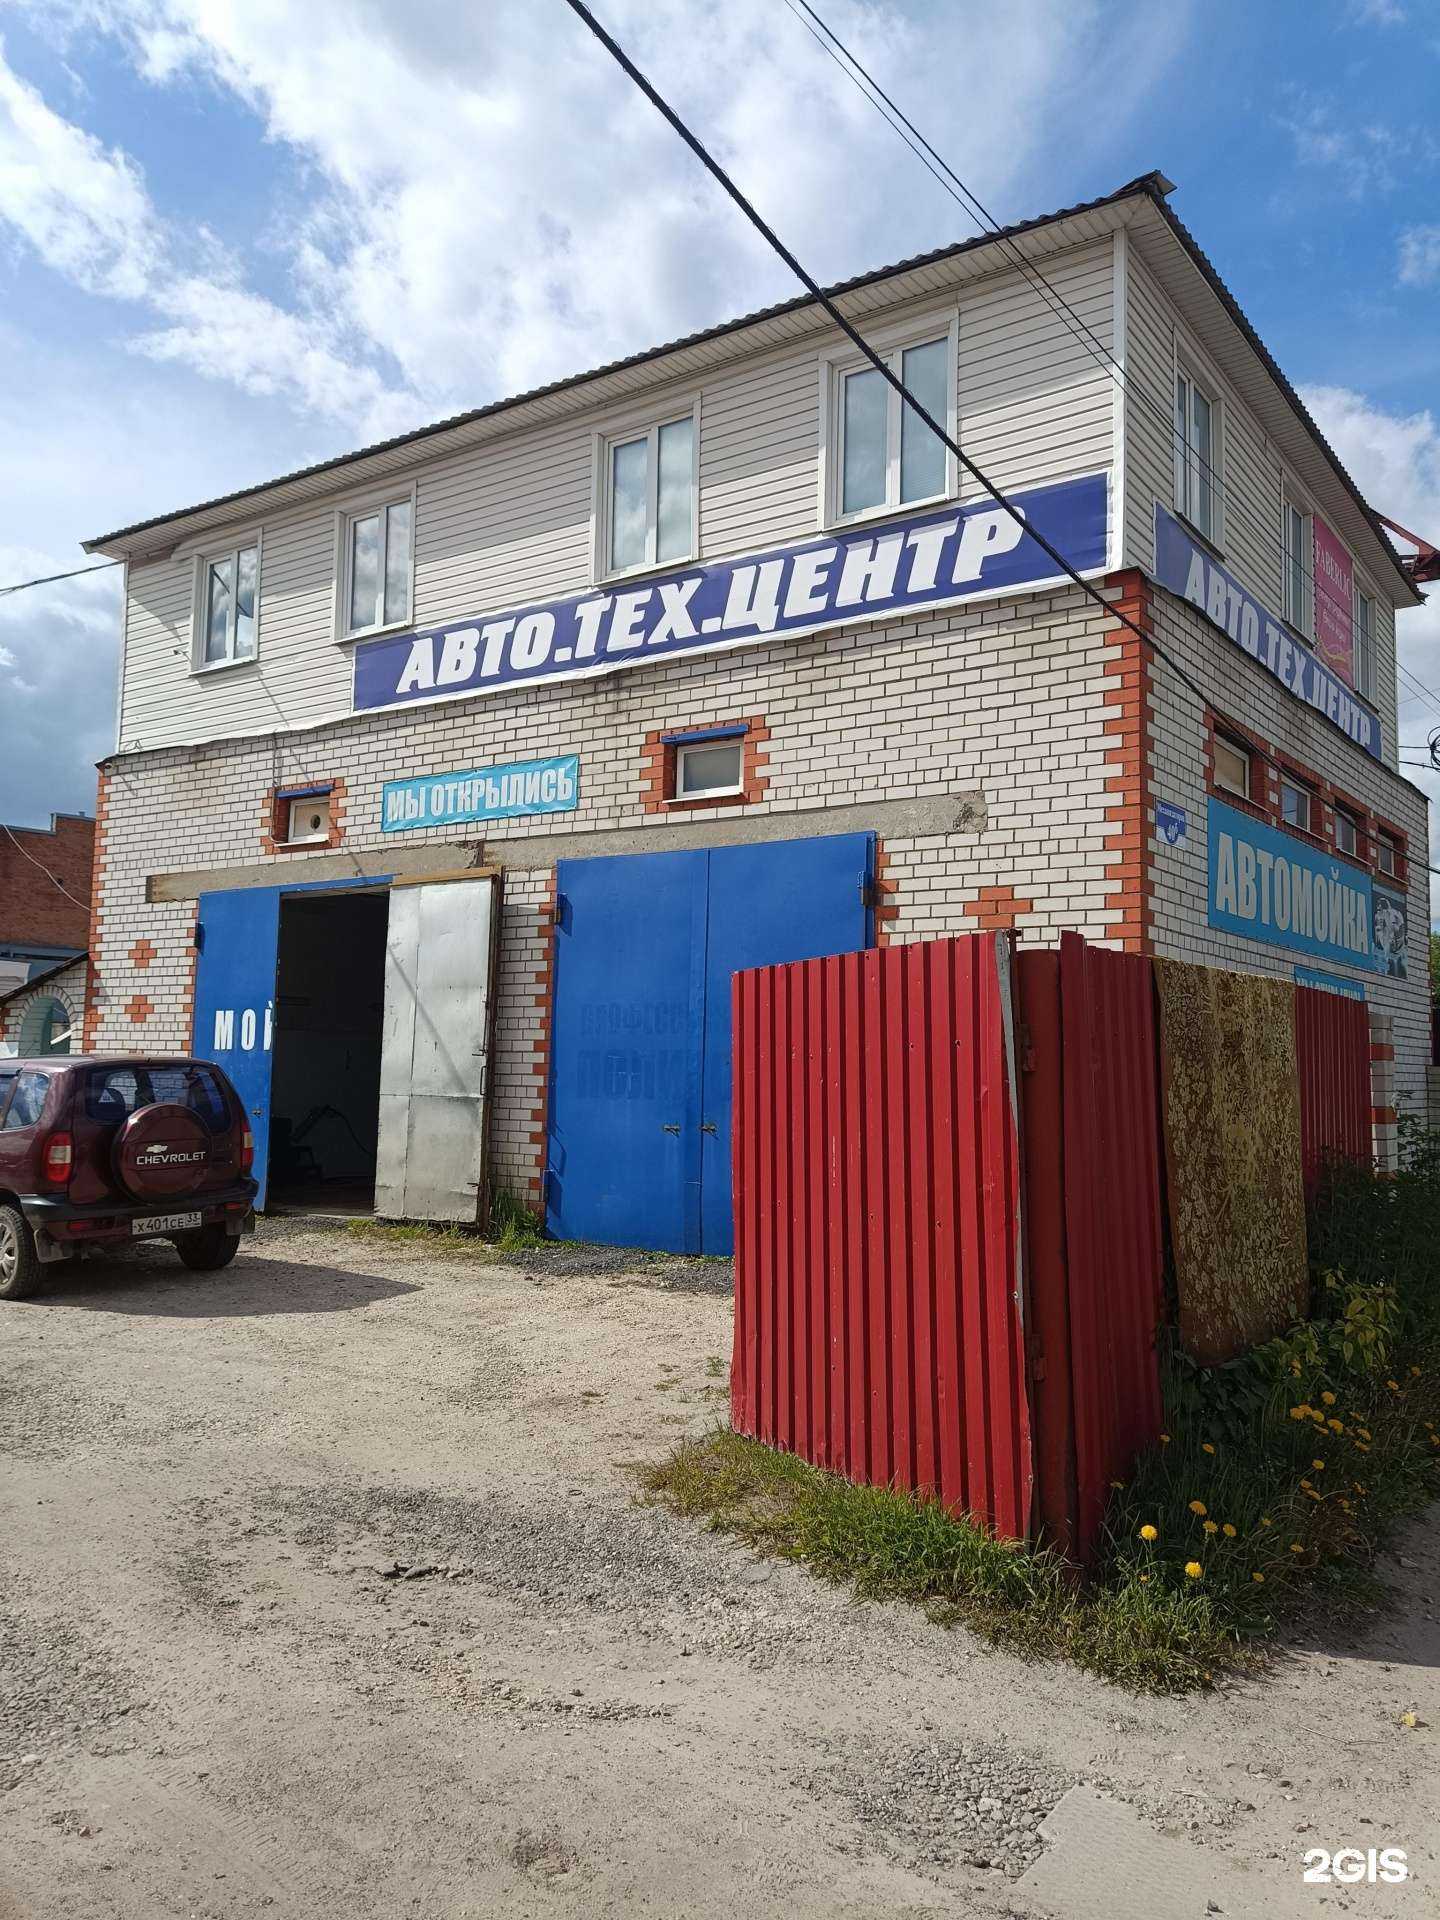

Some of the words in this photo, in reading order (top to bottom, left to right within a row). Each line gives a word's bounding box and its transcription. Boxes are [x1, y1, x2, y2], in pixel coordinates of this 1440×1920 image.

[387, 786, 425, 822] МЫ
[431, 768, 573, 816] ОТКРЫЛИСЬ
[1215, 832, 1369, 954] АВТОМОЙКА
[136, 1151, 206, 1165] CHEVROLET
